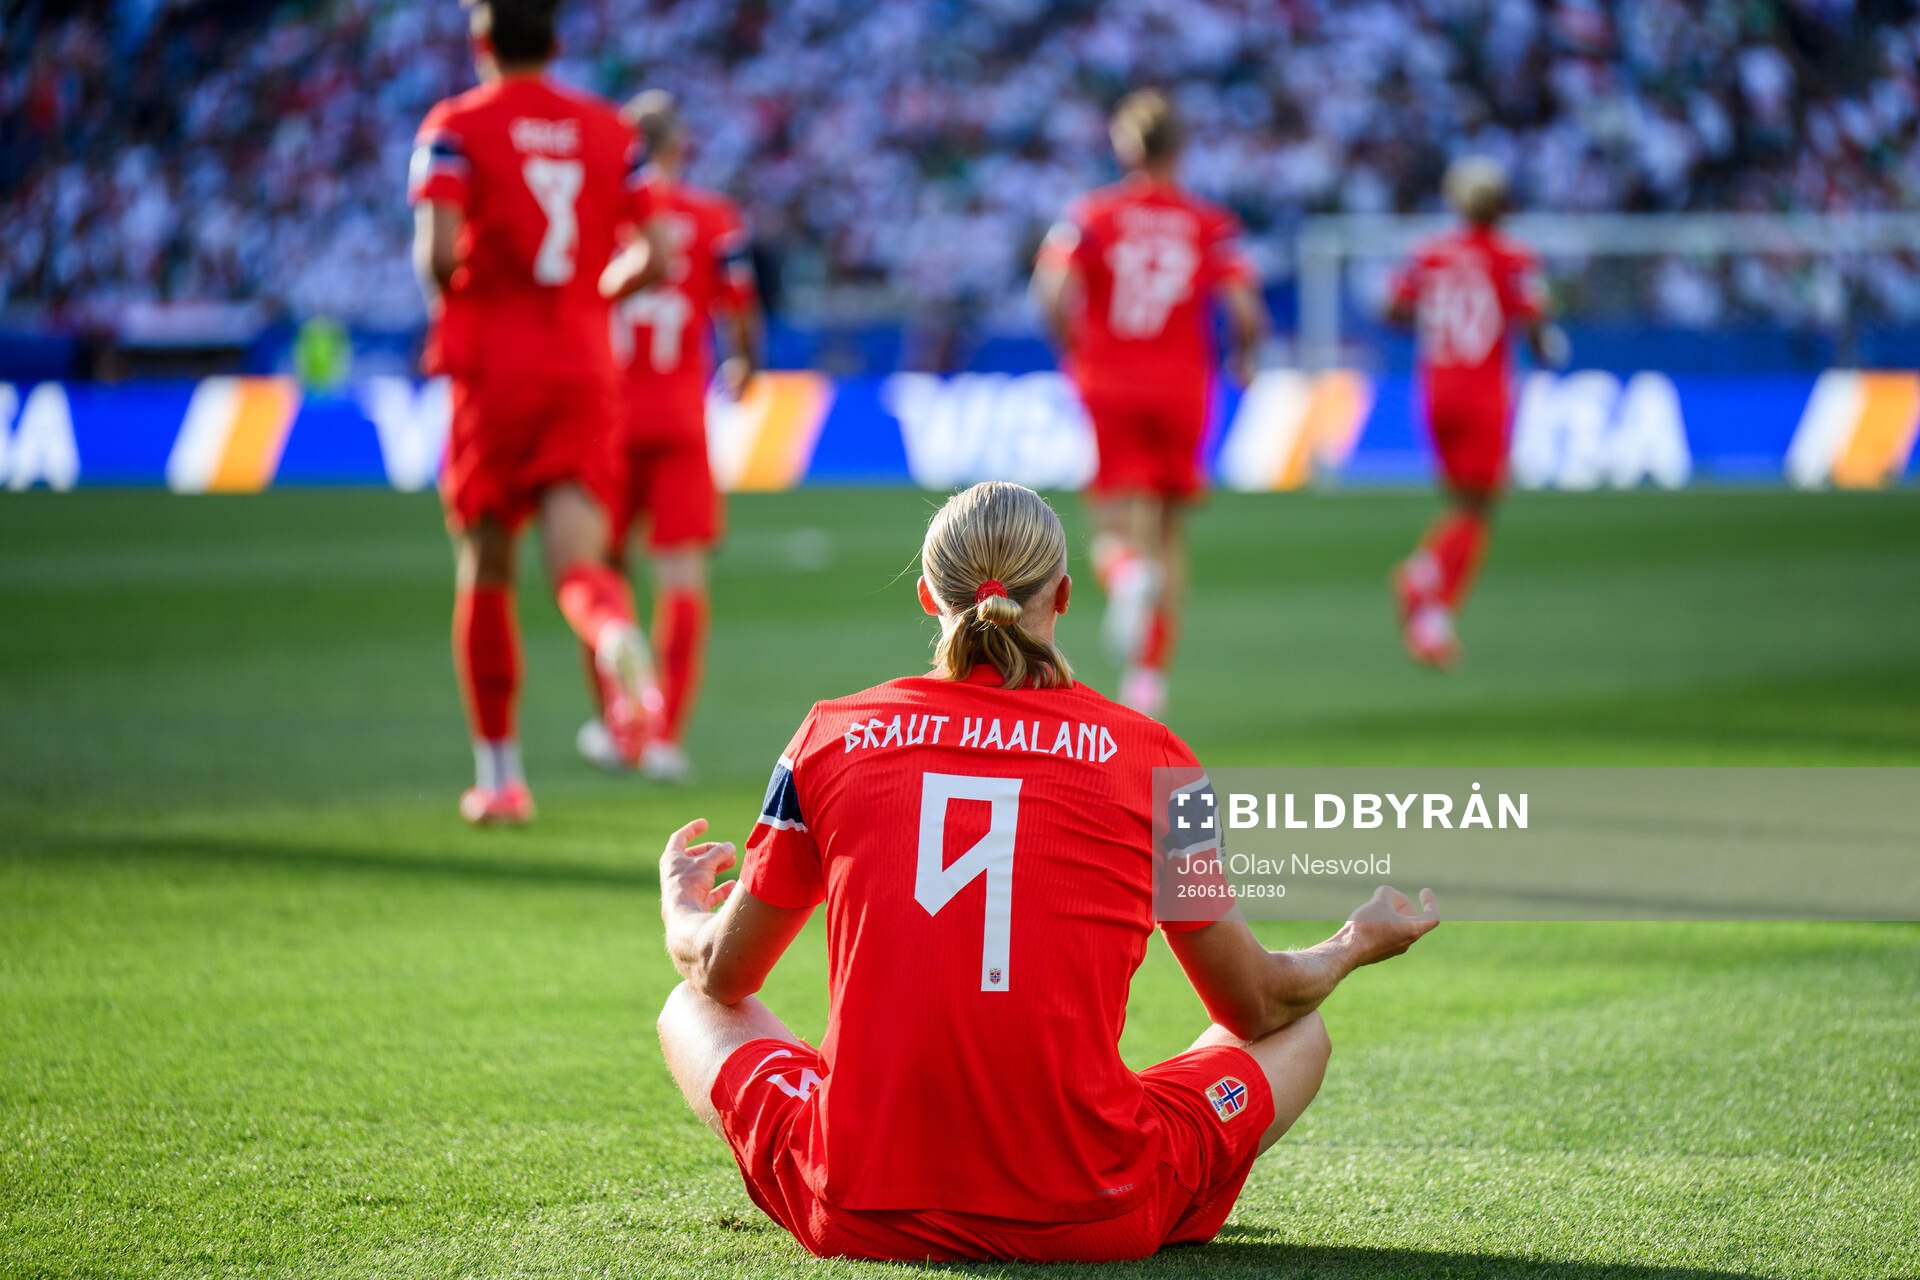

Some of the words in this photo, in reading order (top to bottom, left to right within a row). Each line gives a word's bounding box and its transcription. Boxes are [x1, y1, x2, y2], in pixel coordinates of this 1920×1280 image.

[1508, 369, 1694, 491] ISA
[844, 714, 950, 754] BRAUT
[959, 717, 1118, 763] HAALAND
[914, 772, 1024, 992] 9
